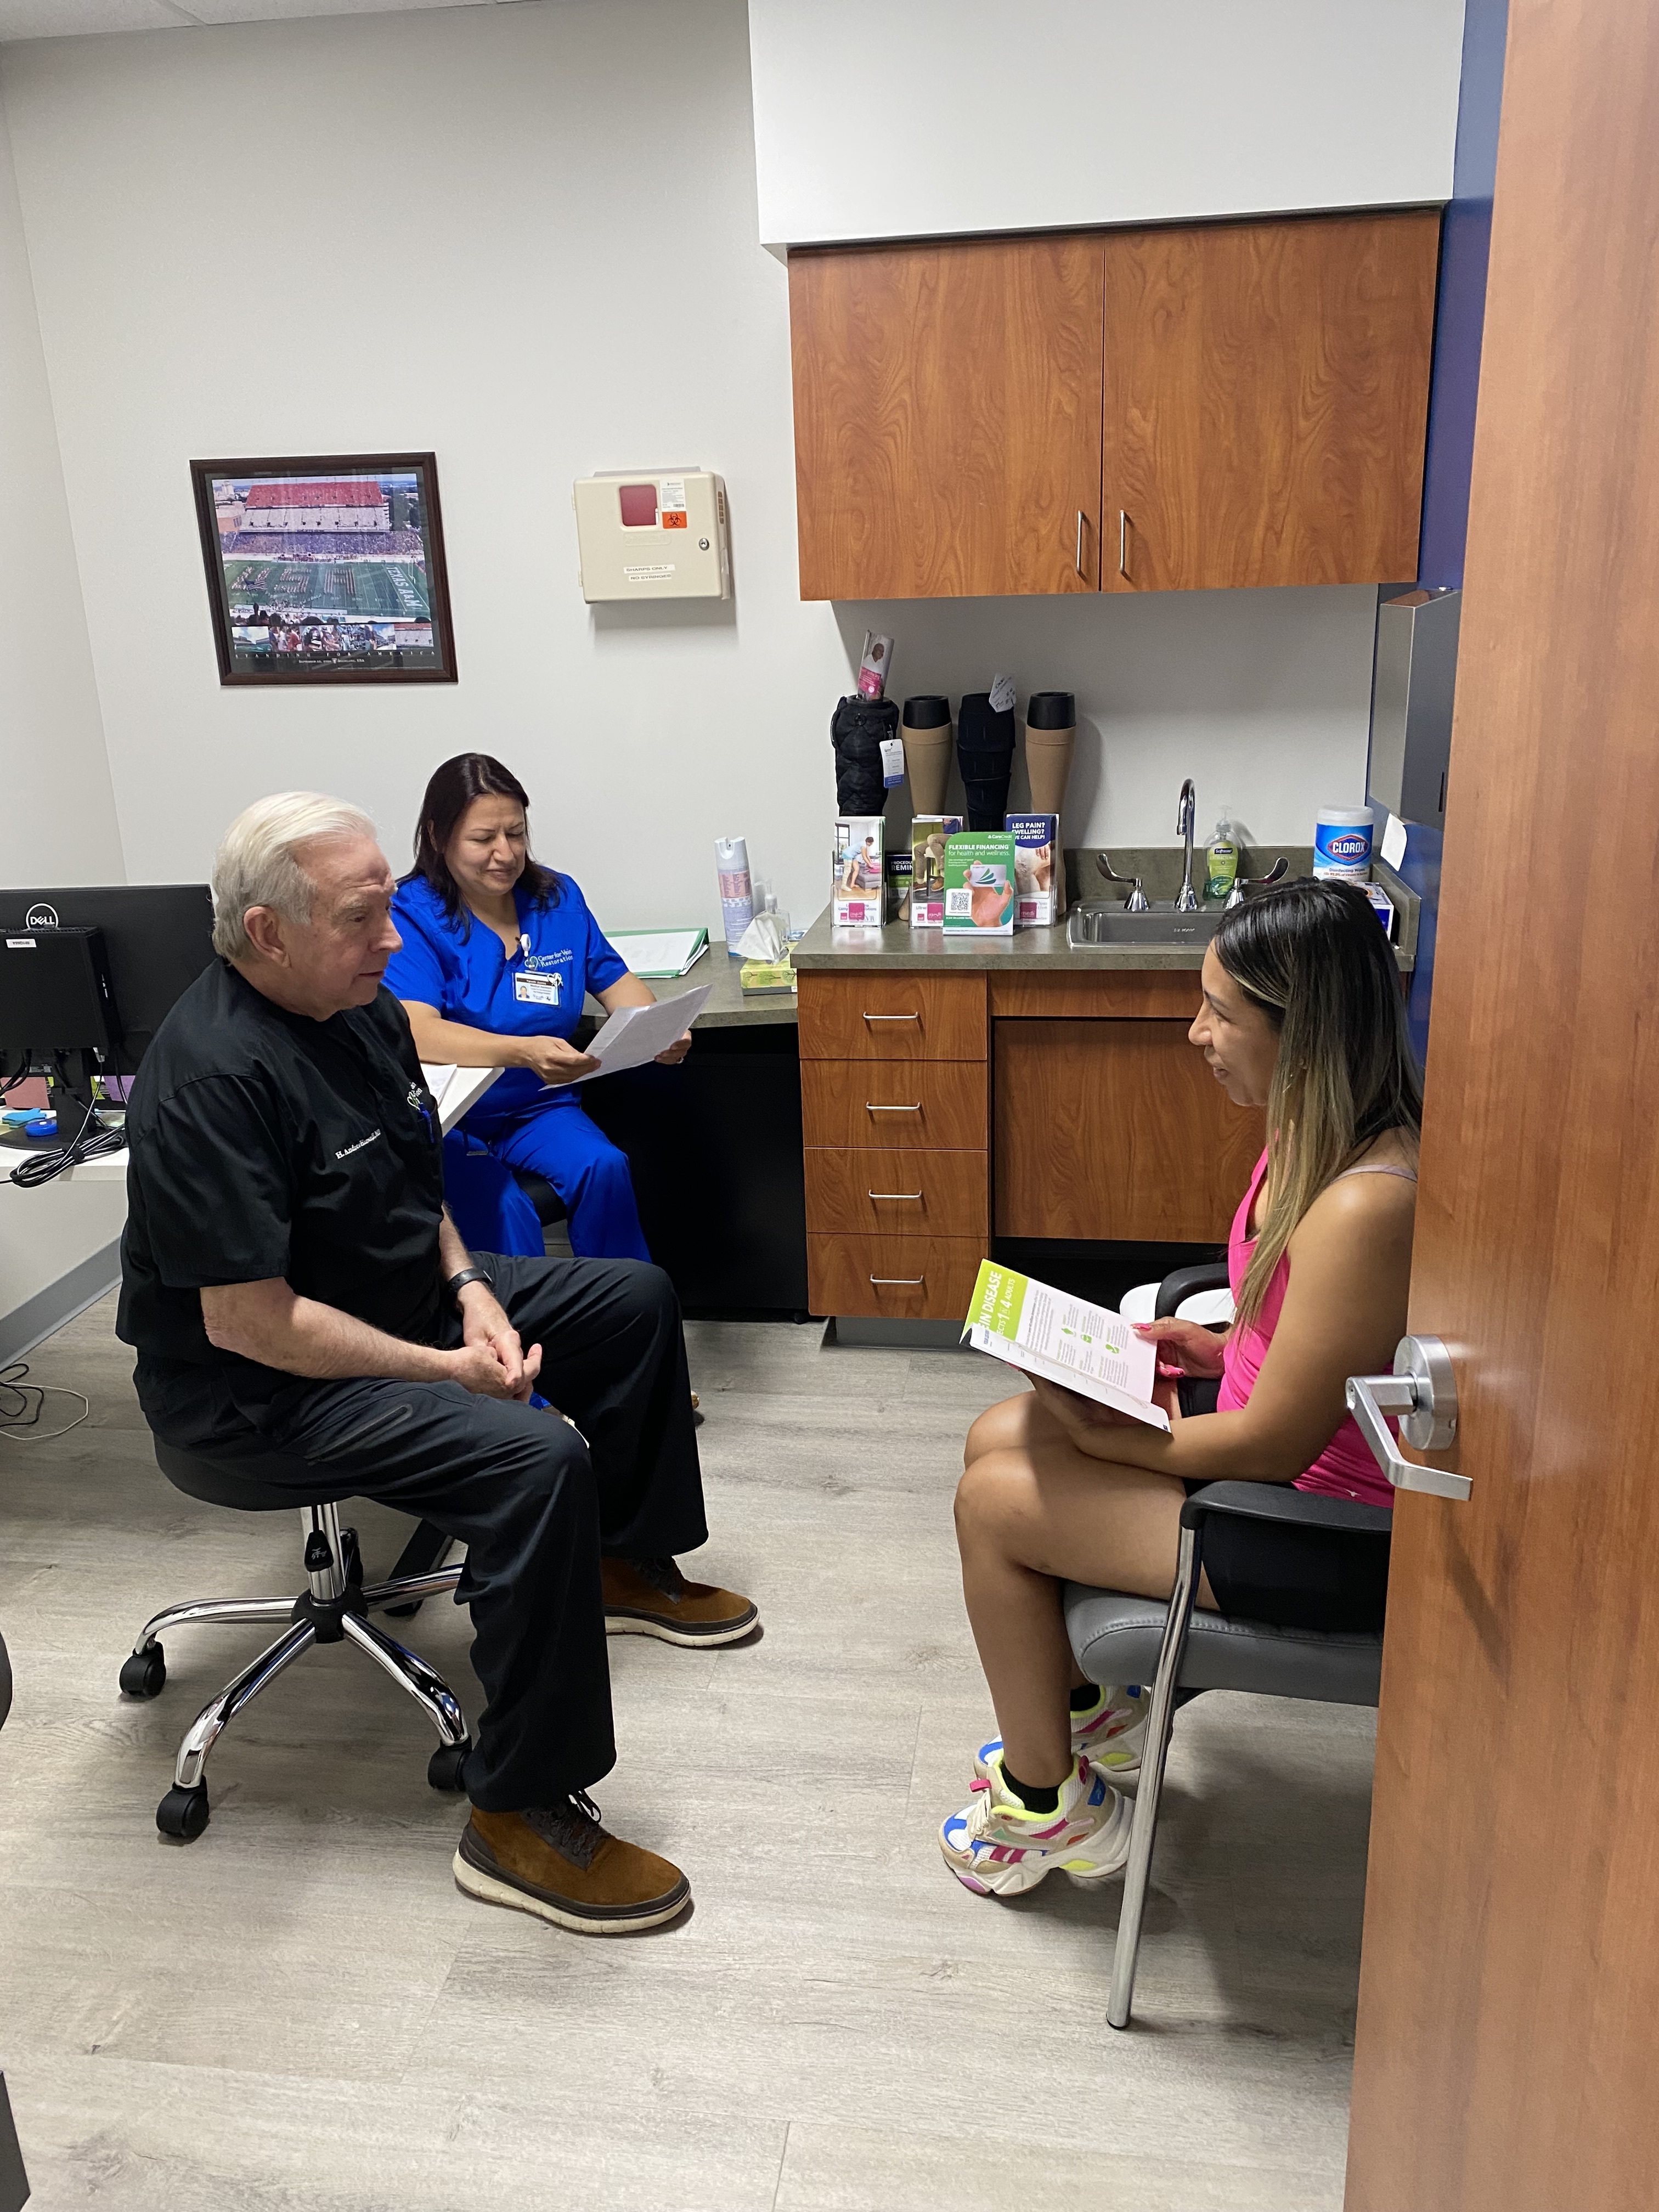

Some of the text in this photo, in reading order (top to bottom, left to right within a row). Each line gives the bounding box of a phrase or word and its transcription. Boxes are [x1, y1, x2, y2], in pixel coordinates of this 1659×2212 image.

[386, 567, 423, 607] TEXAS A&M
[1333, 842, 1365, 853] CLOROX
[30, 916, 55, 925] DELL
[1005, 1278, 1015, 1301] ADULTS
[978, 1270, 1002, 1330] EIN DISEASE
[1000, 1299, 1013, 1308] 4
[996, 1319, 1006, 1335] ECTS
